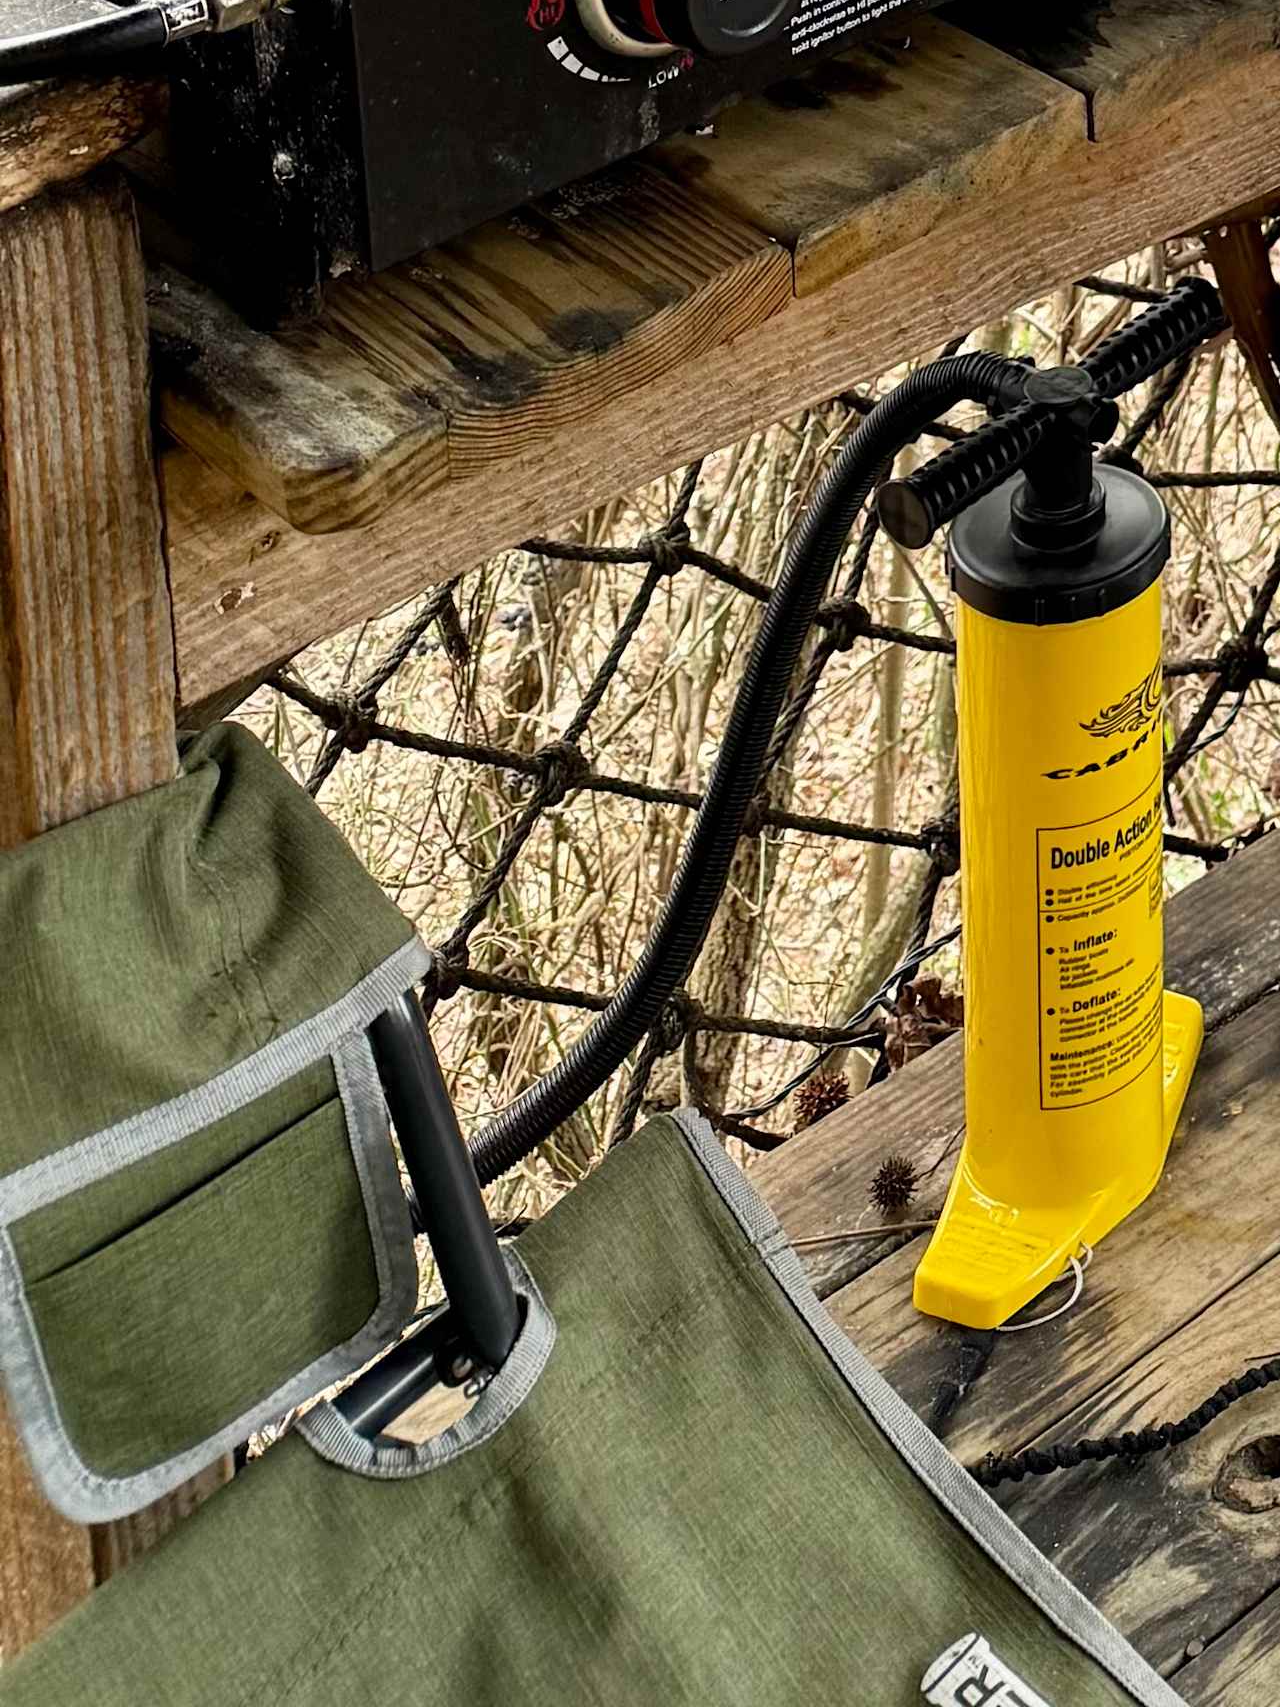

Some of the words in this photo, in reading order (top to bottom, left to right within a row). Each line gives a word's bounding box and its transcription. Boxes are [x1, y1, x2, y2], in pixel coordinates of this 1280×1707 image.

[647, 65, 680, 89] LOW
[1051, 838, 1110, 870] Double
[1113, 808, 1153, 853] Action
[1073, 928, 1118, 952] Inflate:
[1072, 987, 1121, 1013] Deflate:
